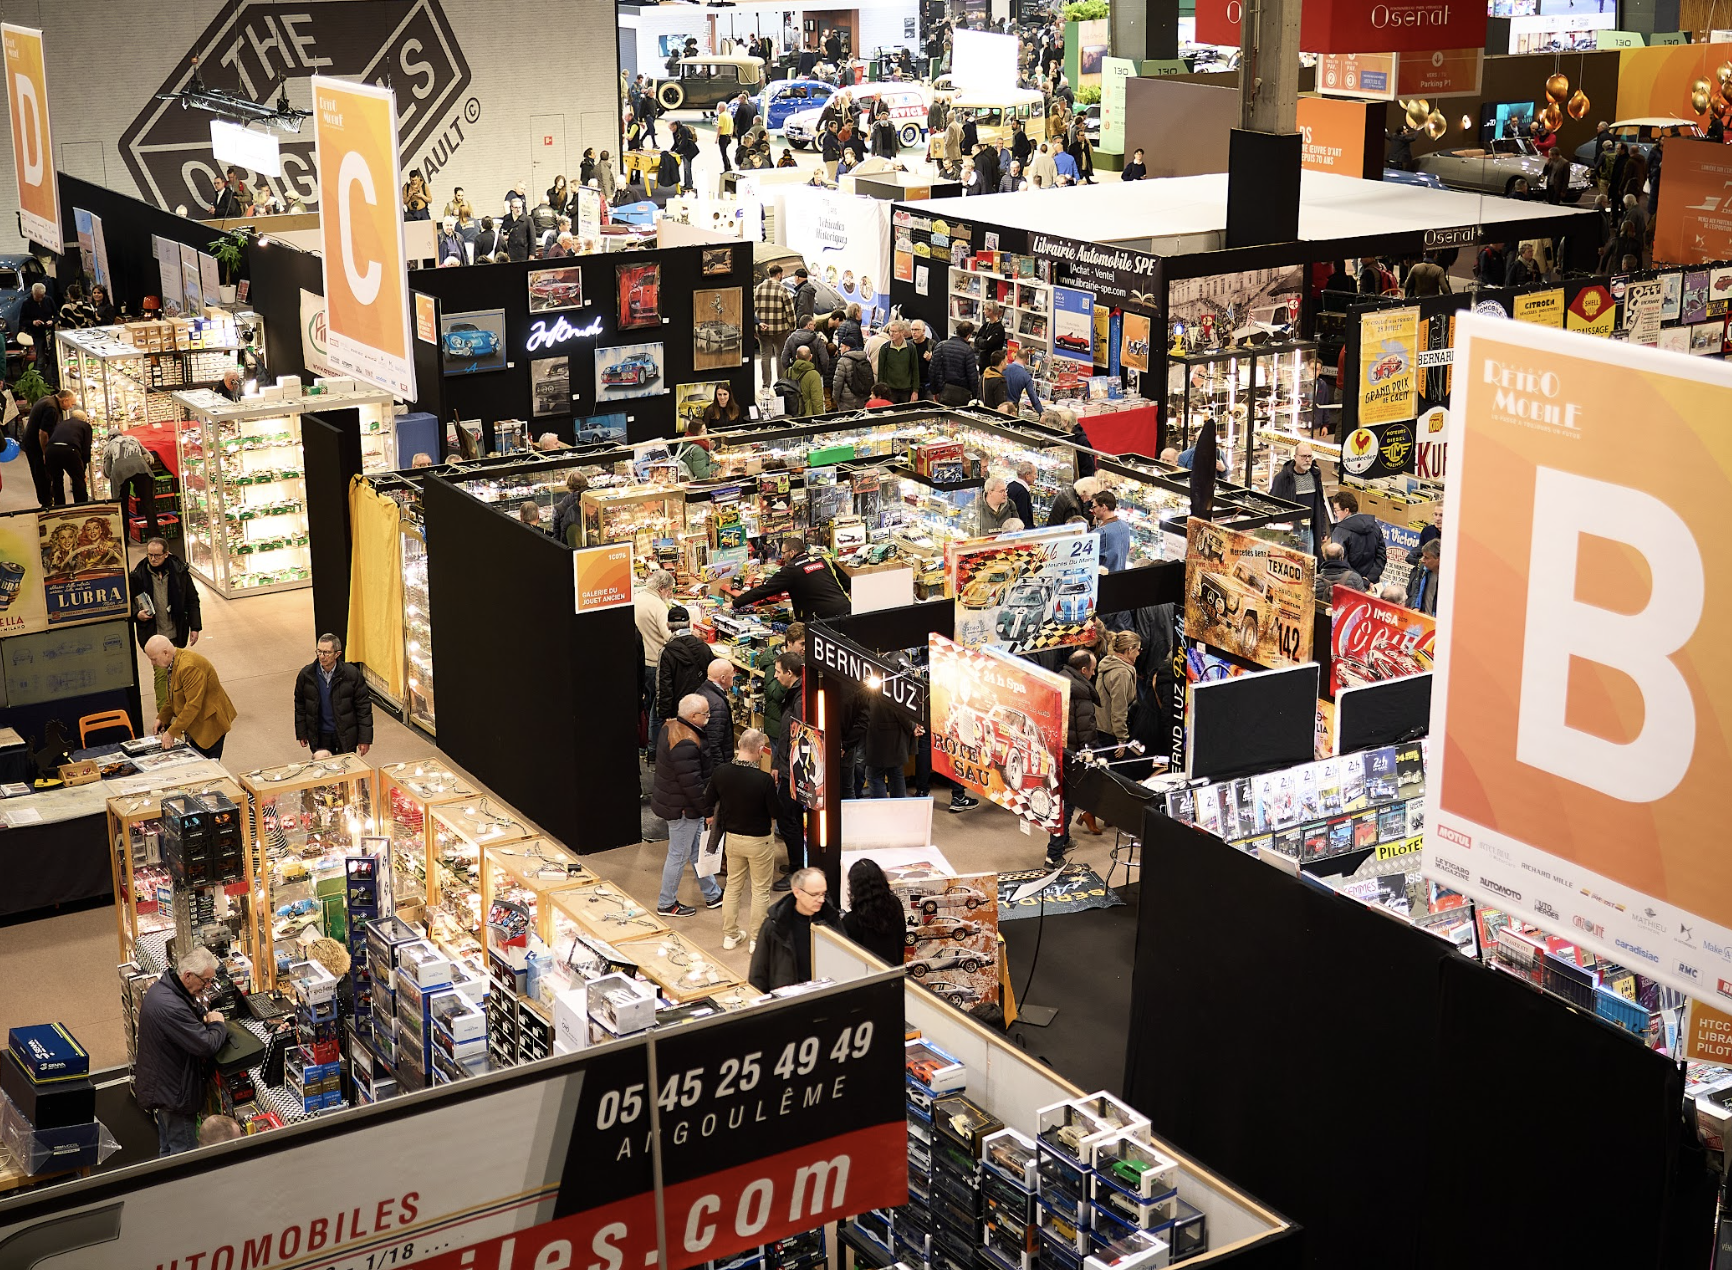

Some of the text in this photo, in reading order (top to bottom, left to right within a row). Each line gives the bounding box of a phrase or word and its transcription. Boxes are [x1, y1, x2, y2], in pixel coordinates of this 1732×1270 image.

[1371, 4, 1452, 29] Osenat
[1615, 38, 1632, 47] 130
[220, 13, 333, 101] THE
[1113, 66, 1129, 76] 130
[1420, 80, 1443, 88] Parking
[15, 73, 43, 188] D
[418, 115, 461, 184] AULT
[1301, 154, 1315, 163] EPUIS
[1316, 155, 1322, 163] 70
[1327, 147, 1342, 157] D'ART
[337, 151, 382, 306] C
[1424, 227, 1476, 246] Osenat
[1033, 236, 1156, 276] Librairie Automobile SPE
[1060, 276, 1127, 297] www.librairie-spe.com
[1418, 350, 1454, 366] BERNAR
[1483, 358, 1560, 398] RETRO
[1365, 377, 1410, 404] GRAND PRIX
[1492, 387, 1582, 431] MOBILE
[1070, 539, 1094, 558] 24
[1230, 547, 1267, 558] Mercedes Benz
[1268, 559, 1301, 580] TEXACO
[58, 587, 123, 608] LUBRA
[582, 589, 608, 598] GALERIE
[582, 593, 626, 606] JOUET ANCIEN
[1373, 607, 1399, 626] IMSA
[1280, 622, 1300, 663] 142
[1516, 466, 1705, 803] B
[814, 636, 917, 711] BERND LUZ
[1172, 647, 1187, 679] Pop
[1006, 678, 1027, 694] Spa
[1173, 684, 1185, 720] LUZ
[932, 732, 979, 765] ROTE
[954, 759, 990, 787] SAU
[1439, 827, 1470, 848] MOTUL
[1435, 862, 1470, 882] MAGAZINE
[1521, 862, 1574, 889] RICHARD MILLE
[1480, 877, 1522, 900] AUTOMOTO
[1534, 905, 1560, 921] HEROES
[1632, 913, 1667, 934] MATHIEU
[1615, 938, 1660, 964] caradisiac
[1703, 940, 1723, 955] Make
[1678, 964, 1698, 979] RMC
[1699, 1018, 1731, 1031] HTCC
[1696, 1042, 1732, 1055] PILOT
[597, 1020, 875, 1131] 05 45 25 49 49
[461, 1154, 851, 1270] es.com
[156, 1191, 420, 1270] TOMOBILES
